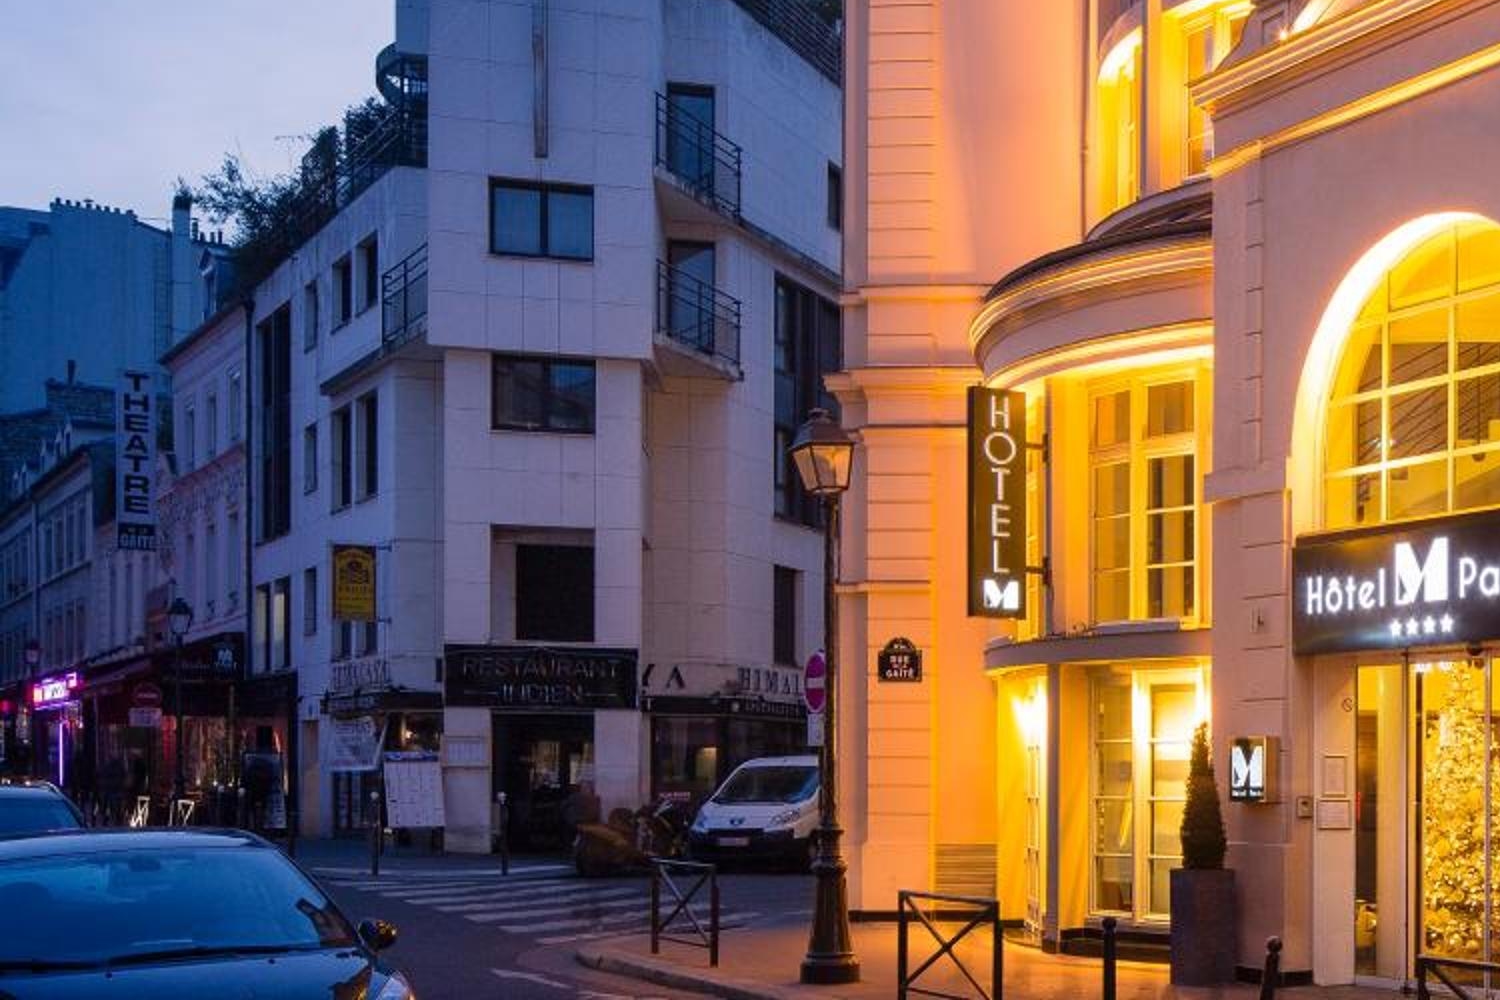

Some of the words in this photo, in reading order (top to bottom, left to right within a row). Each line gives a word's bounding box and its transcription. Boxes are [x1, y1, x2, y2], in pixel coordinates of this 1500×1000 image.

[123, 370, 149, 514] THEATRE
[983, 394, 1017, 574] HOTEL
[983, 579, 1019, 611] M
[1306, 567, 1385, 616] Hôtel
[1394, 536, 1449, 606] M
